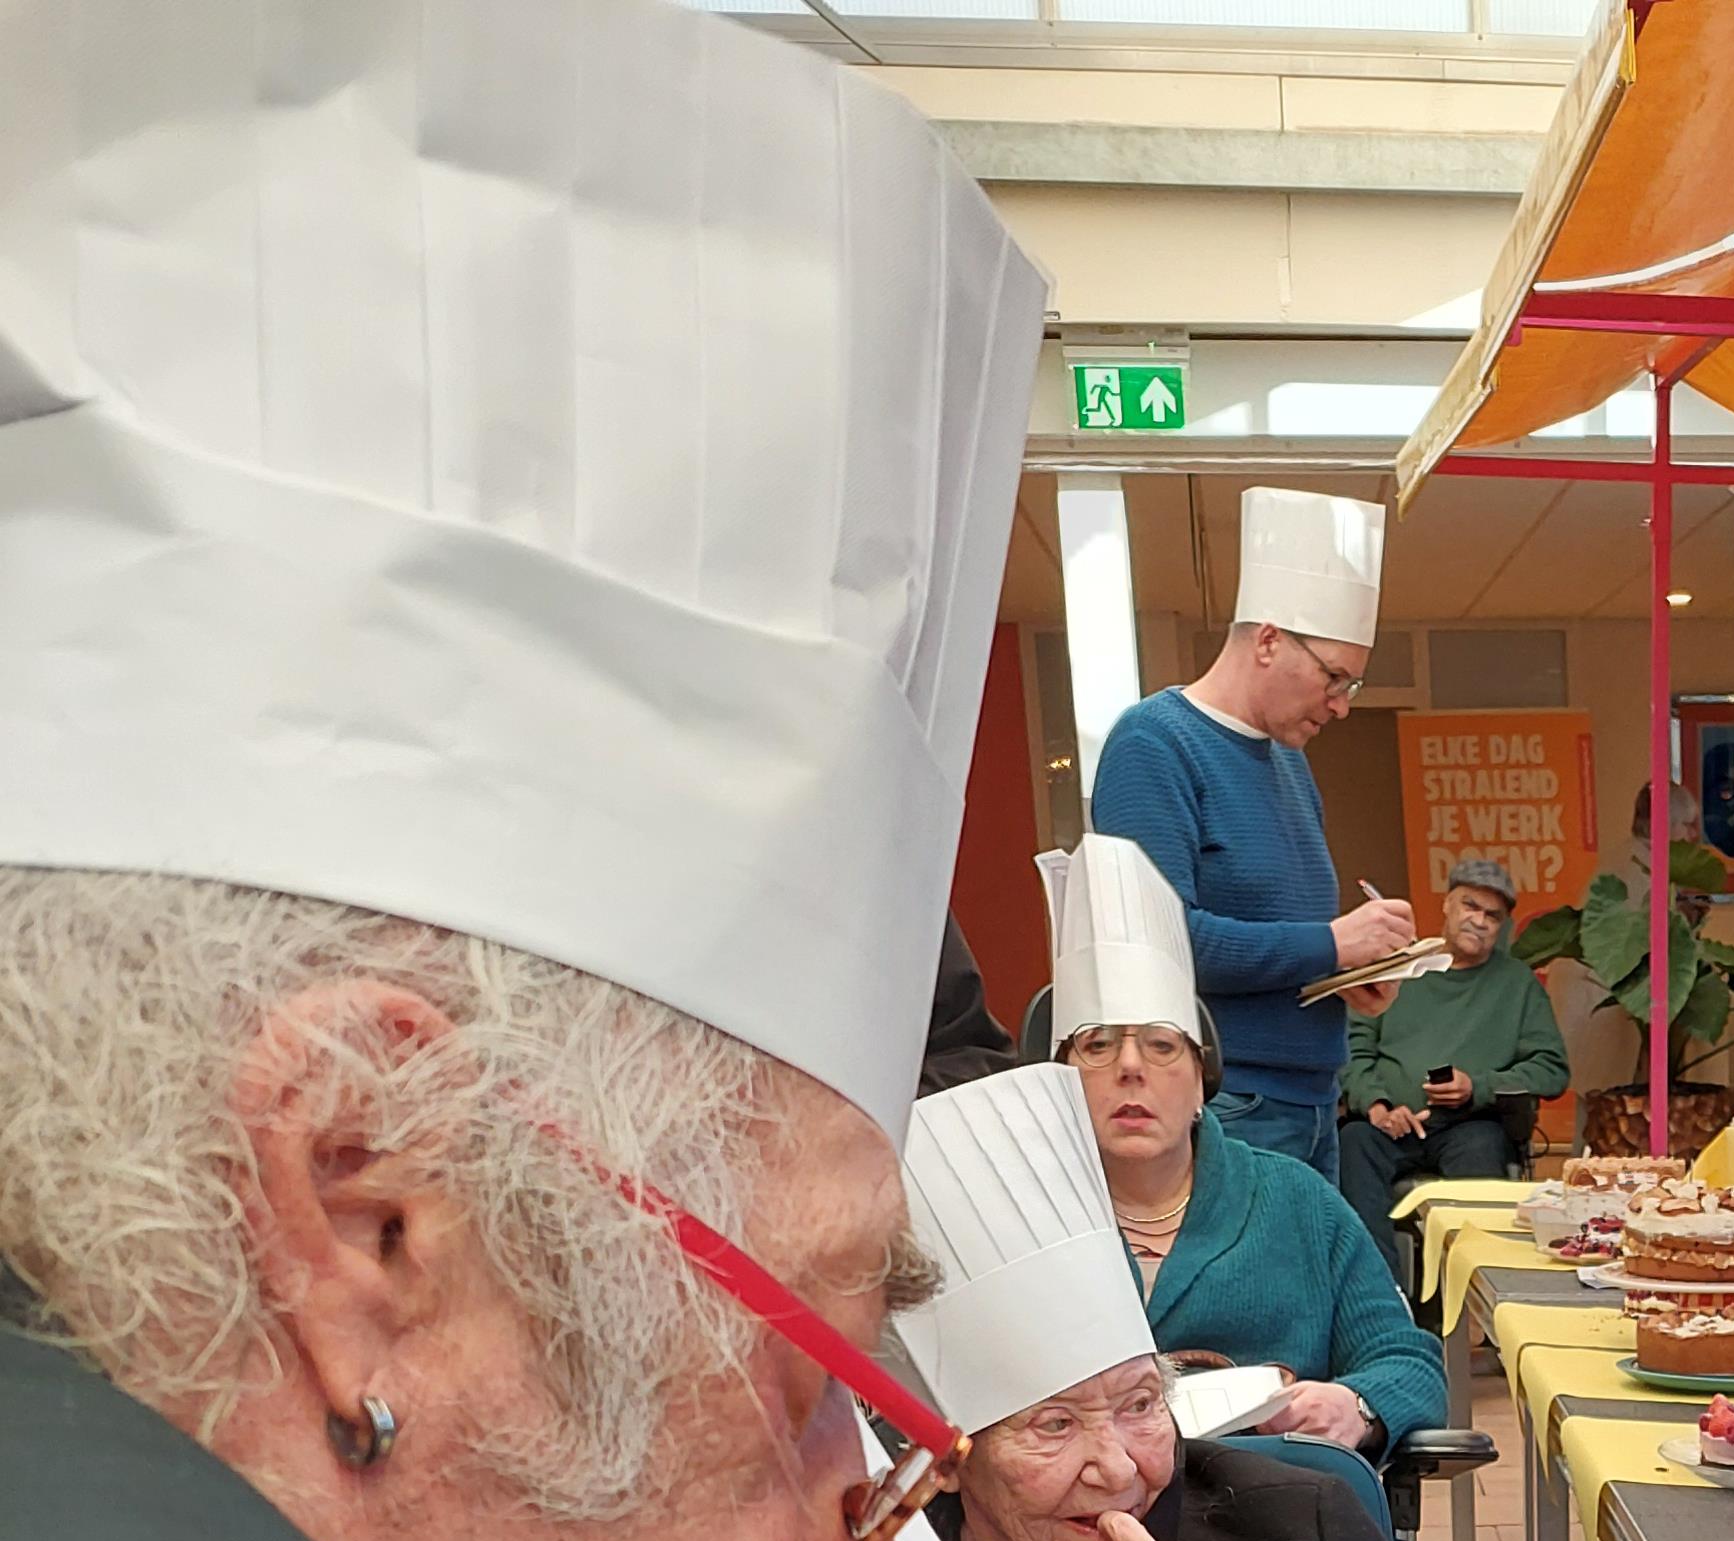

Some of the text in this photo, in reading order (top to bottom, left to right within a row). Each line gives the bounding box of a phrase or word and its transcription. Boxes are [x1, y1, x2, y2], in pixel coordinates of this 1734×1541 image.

[1420, 734, 1544, 765] ELKE DAG
[1423, 768, 1559, 800] STRALEND
[1427, 804, 1565, 842] JE WERK
